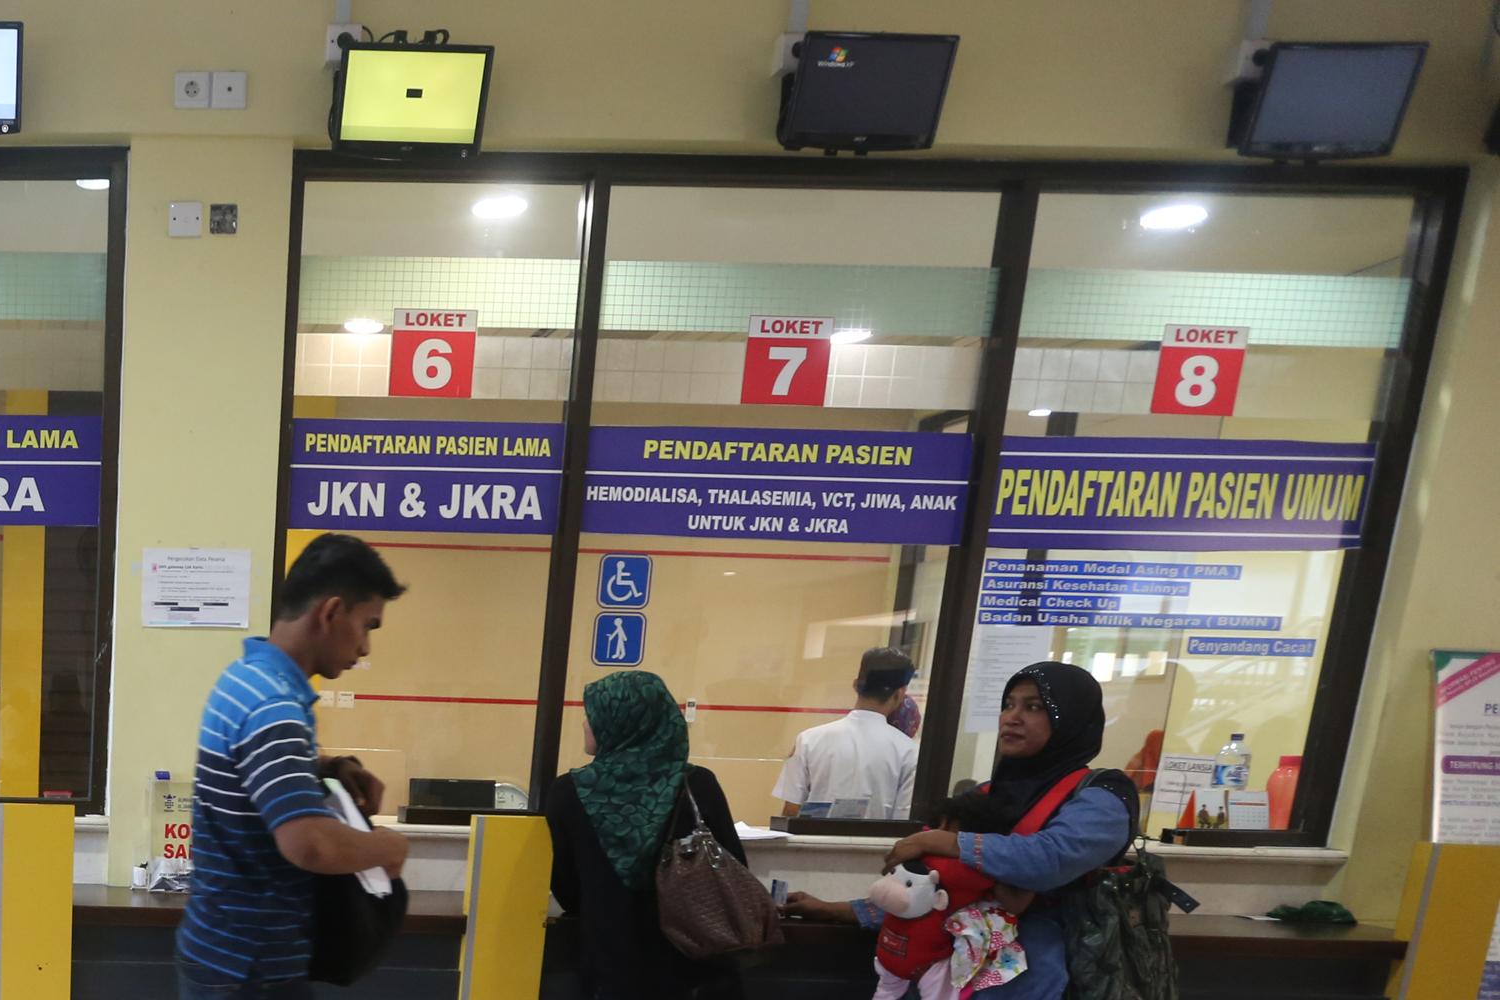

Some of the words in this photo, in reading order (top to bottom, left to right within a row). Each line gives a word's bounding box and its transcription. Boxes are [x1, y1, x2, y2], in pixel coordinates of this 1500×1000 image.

[405, 312, 467, 327] LOKET
[760, 319, 823, 335] LOKET
[1175, 329, 1238, 344] LOKET
[412, 338, 452, 390] 6
[768, 346, 807, 396] 7
[1174, 355, 1219, 407] 8
[6, 429, 79, 449] LAMA
[305, 432, 431, 455] PENDAFTARAN
[435, 435, 499, 456] PASIEN
[502, 437, 551, 458] LAMA
[643, 439, 819, 464] PENDAFTARAN
[825, 444, 913, 466] PASIEN
[307, 481, 386, 517] JKN
[399, 482, 427, 518] &
[439, 484, 542, 521] JKRA
[586, 486, 703, 507] HEMODIALISA,
[707, 489, 817, 510] THALASEMIA,
[822, 492, 857, 512] VCT,
[860, 493, 905, 512] JIWA,
[910, 495, 958, 511] ANAK
[994, 468, 1181, 517] PENDAFTARAN
[1183, 472, 1279, 520] PASIEN
[1280, 475, 1365, 522] UMUM
[687, 514, 746, 531] UNTUK
[749, 516, 784, 532] JKN
[788, 517, 800, 533] &
[804, 518, 848, 534] JKRA
[988, 560, 1079, 573] Penanaman
[1084, 563, 1131, 575] Modal
[1135, 564, 1179, 578] Asing
[1194, 566, 1229, 577] PMA
[986, 579, 1049, 590] Asuransi
[1053, 580, 1128, 592] Kesehatan
[1132, 582, 1188, 595] Lainnya
[983, 596, 1041, 607] Medical
[1046, 597, 1092, 609] Check
[1097, 598, 1117, 610] Up
[981, 612, 1032, 623] Badan
[1037, 613, 1088, 625] Usaha
[1093, 614, 1133, 626] Milik
[1140, 616, 1201, 628] Negara
[1217, 617, 1268, 628] BUMN
[1190, 639, 1269, 655] Penyandang
[1273, 640, 1313, 654] Cacat
